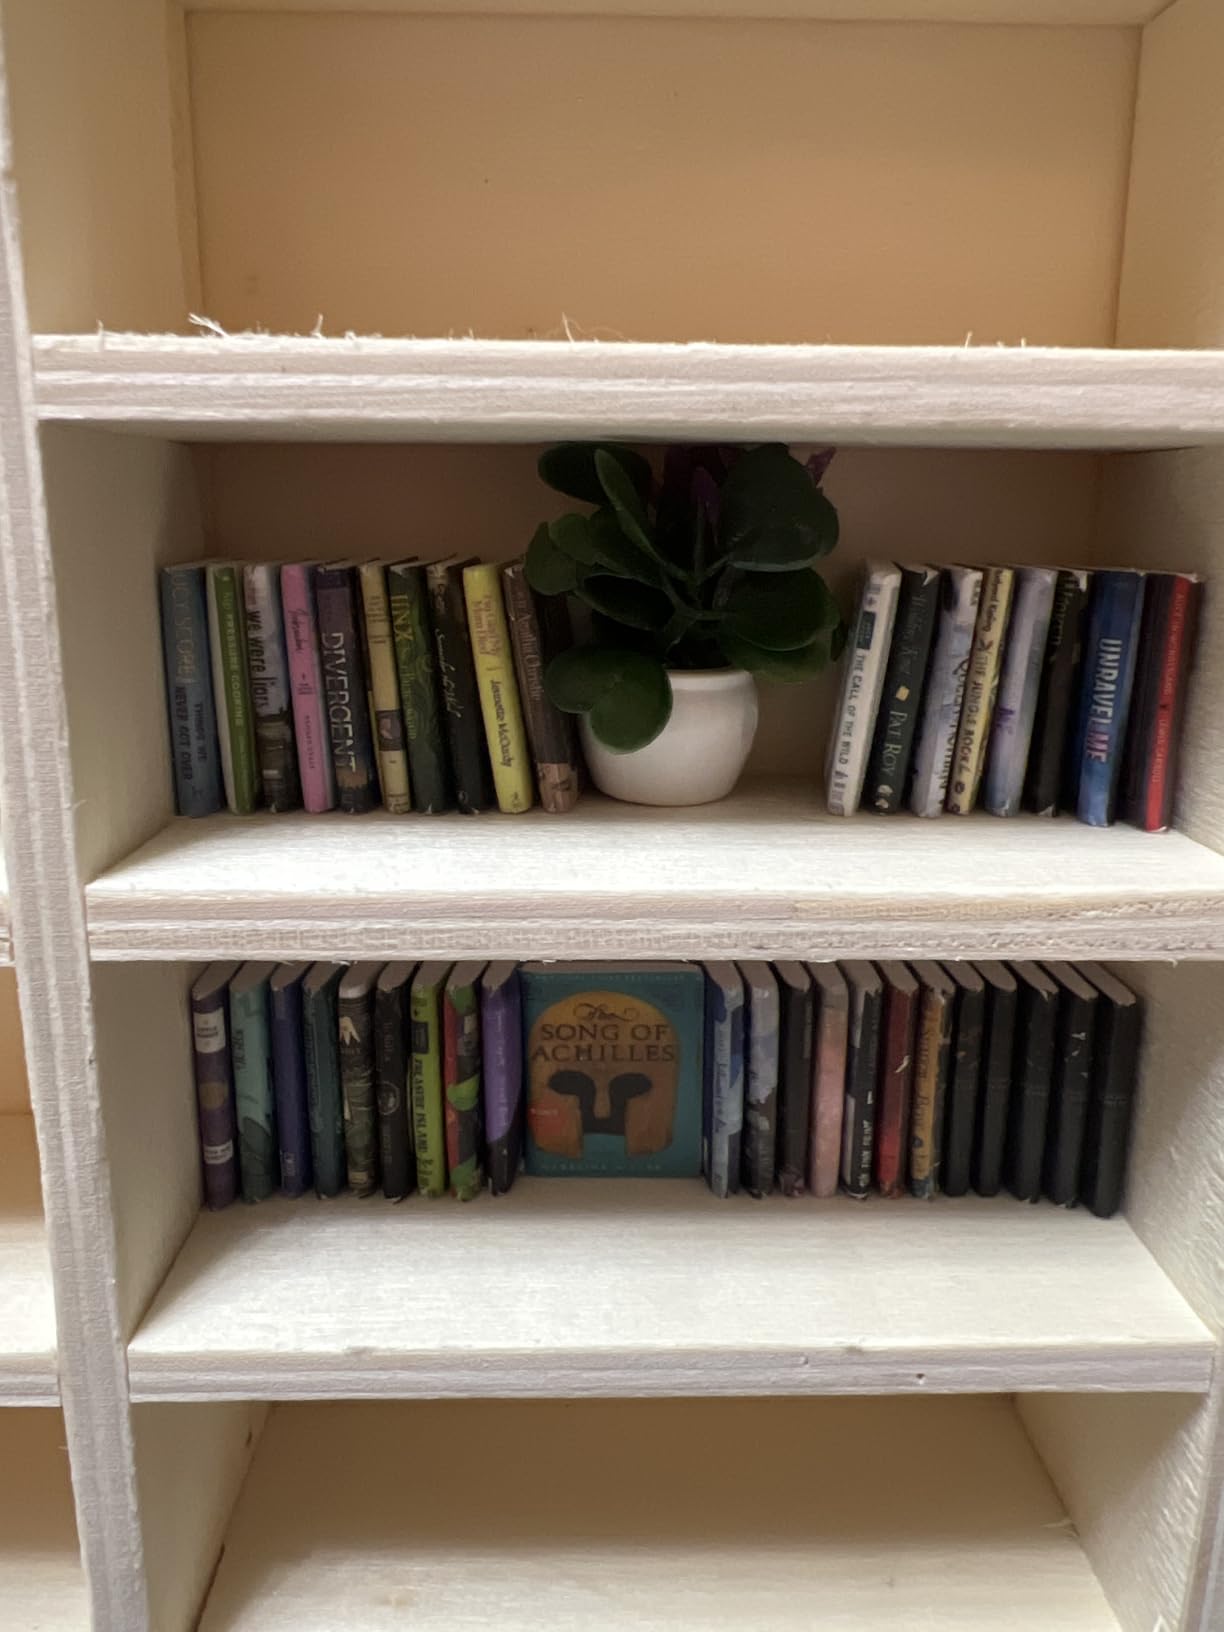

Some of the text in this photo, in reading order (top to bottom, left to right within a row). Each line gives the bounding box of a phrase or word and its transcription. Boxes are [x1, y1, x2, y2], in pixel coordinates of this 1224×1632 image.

[249, 610, 263, 631] we
[250, 636, 266, 673] were
[252, 676, 277, 710] liars
[850, 675, 863, 700] CALL
[321, 632, 357, 773] DIVERGENT
[1085, 638, 1123, 763] UNRAVEL ME
[838, 740, 851, 765] WILD
[541, 1024, 669, 1041] SONG OF
[532, 1044, 676, 1062] ACHILLES
